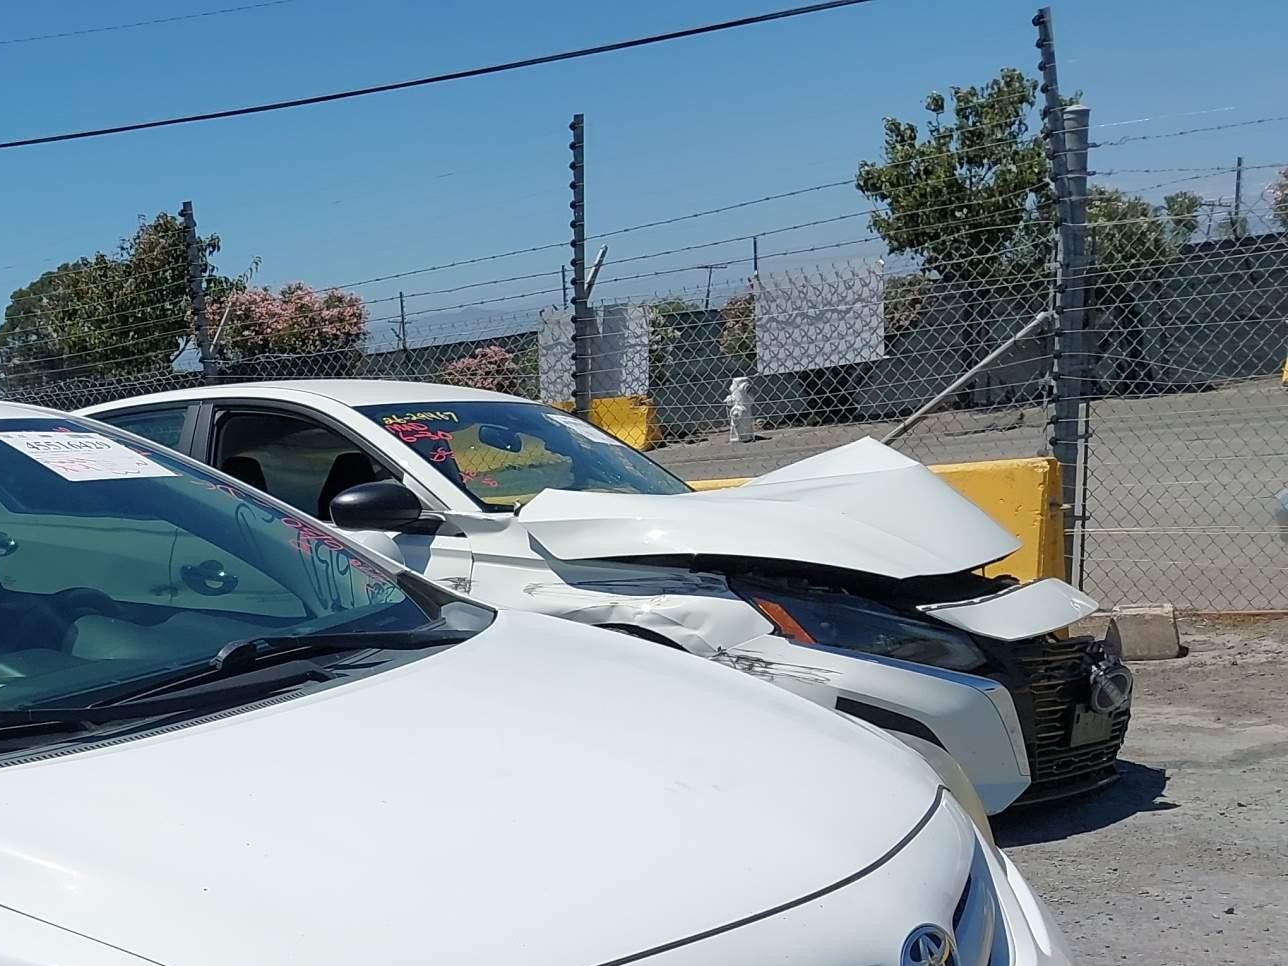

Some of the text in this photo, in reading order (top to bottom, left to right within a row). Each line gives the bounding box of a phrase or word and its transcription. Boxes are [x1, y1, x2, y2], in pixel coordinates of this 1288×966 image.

[385, 422, 429, 434] MAD
[399, 430, 454, 443] 6-30
[25, 440, 112, 451] 45516429
